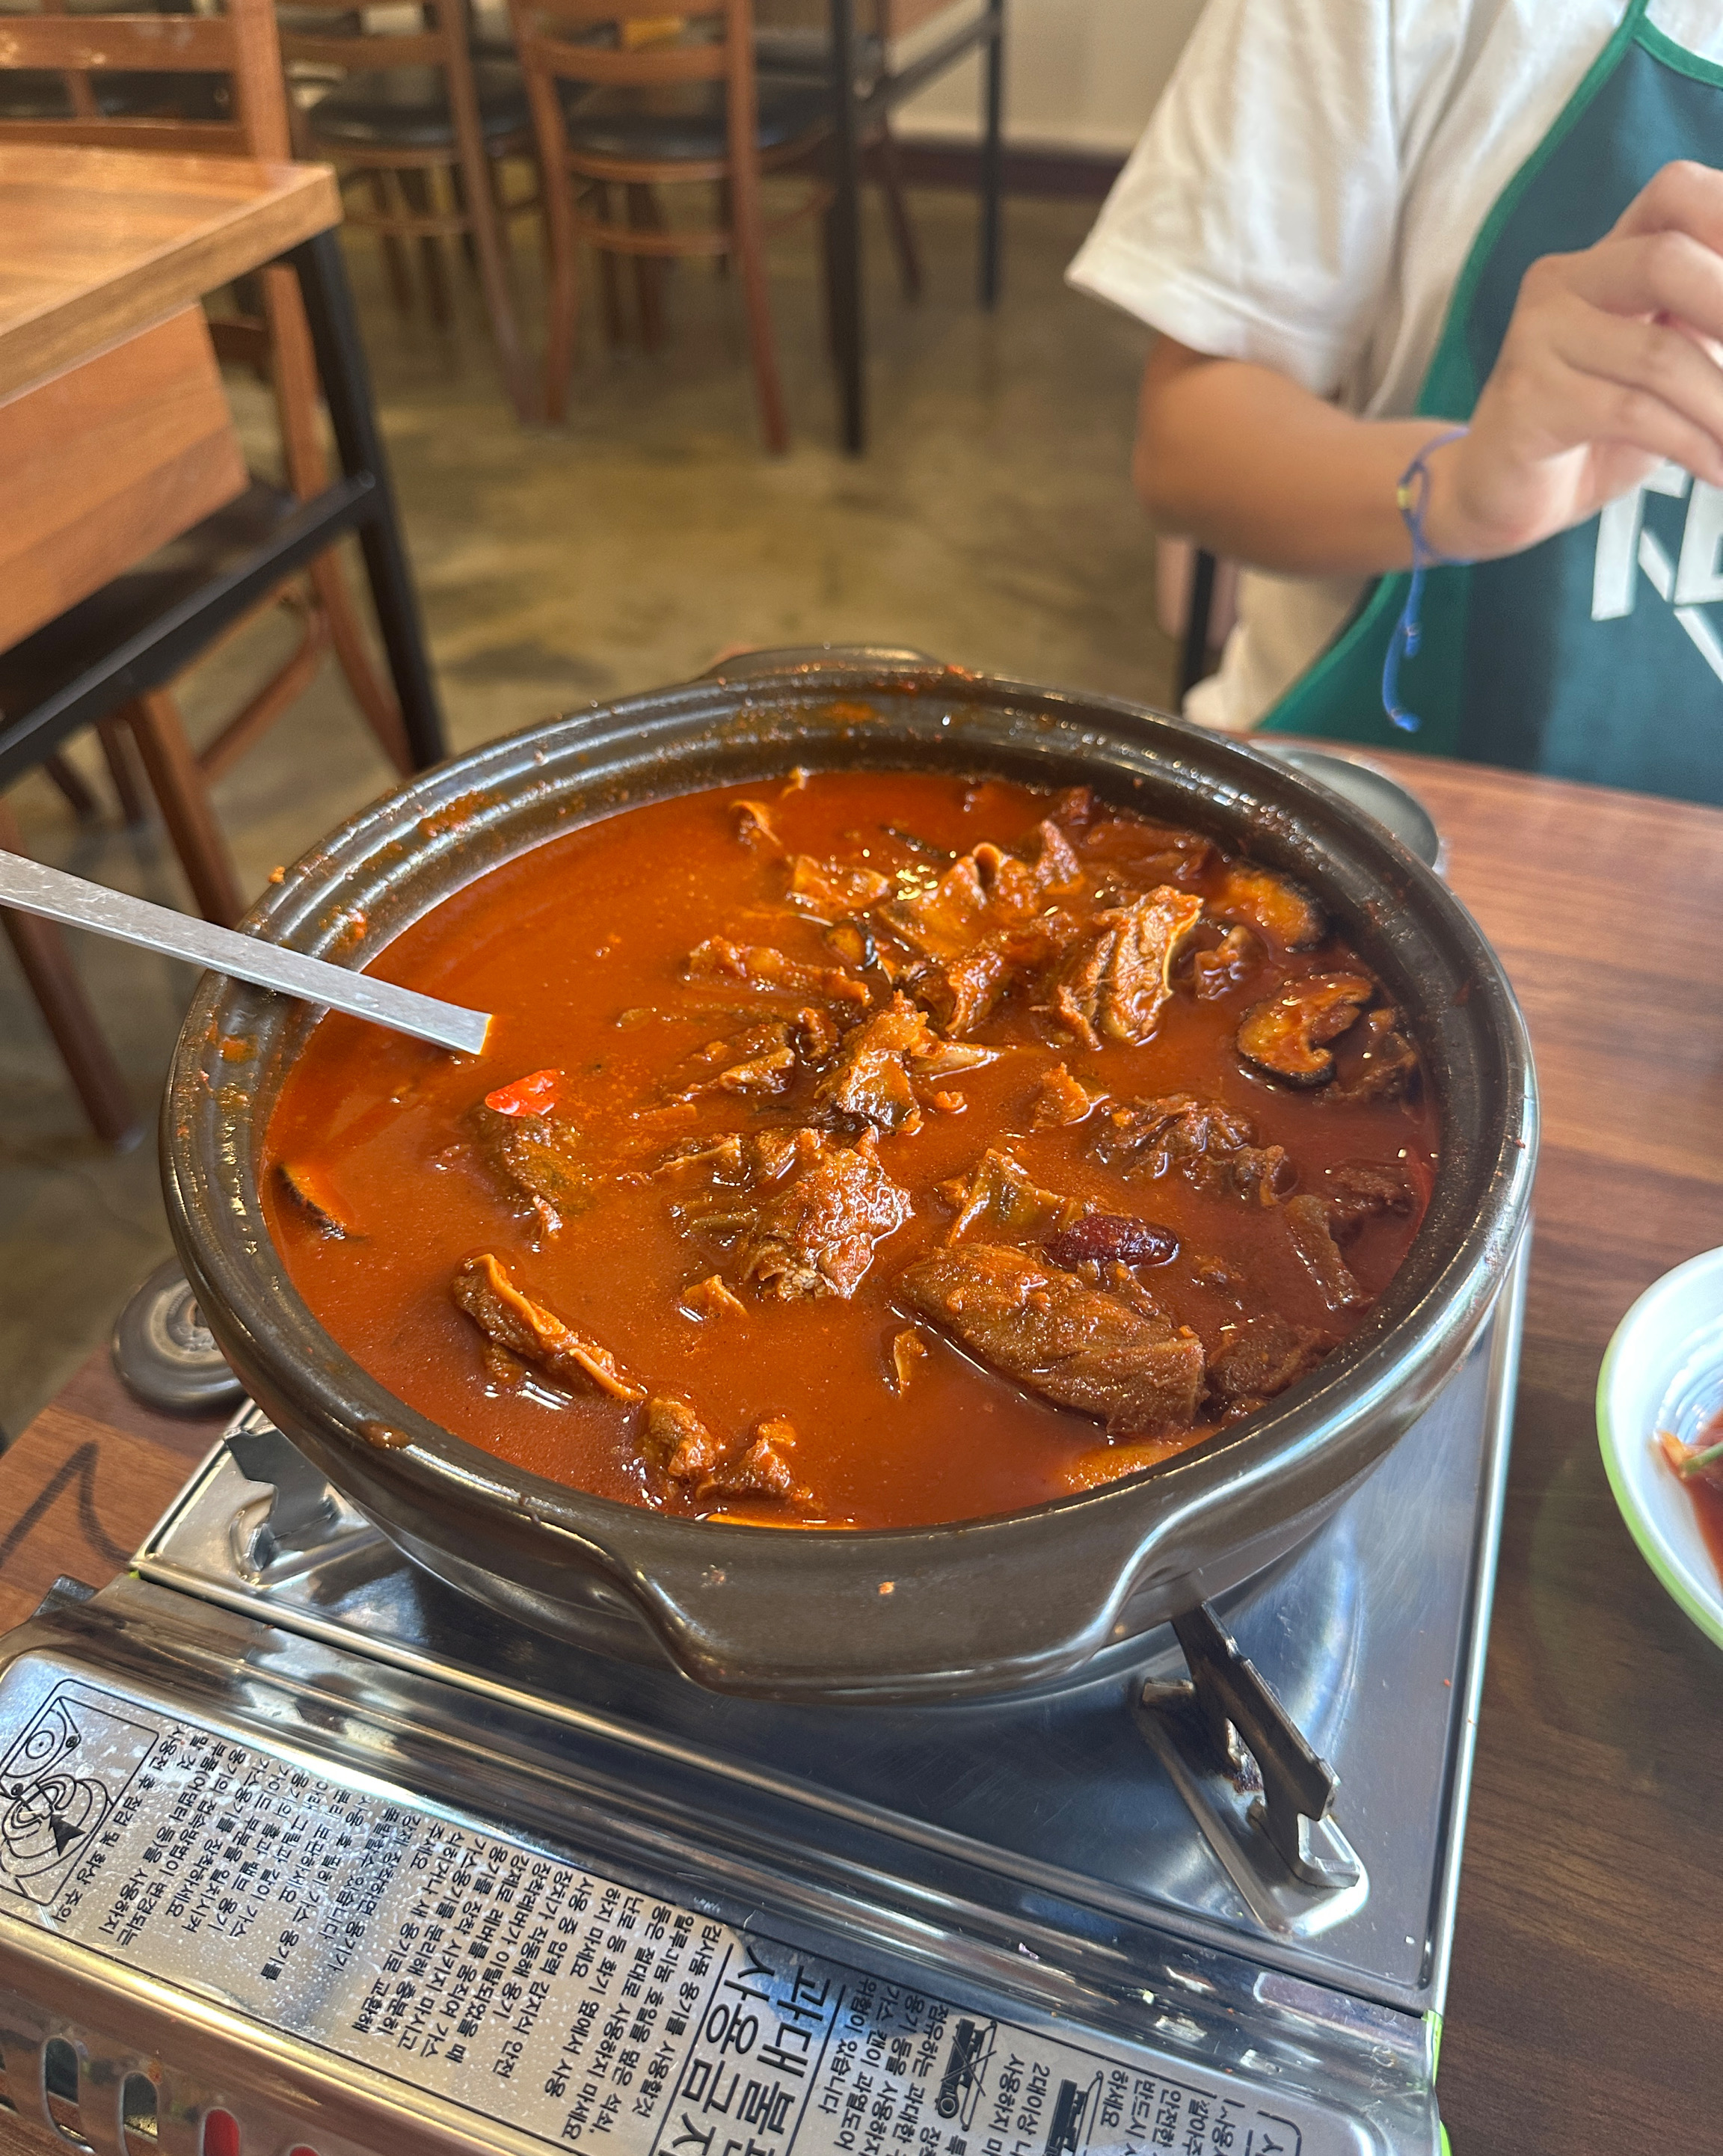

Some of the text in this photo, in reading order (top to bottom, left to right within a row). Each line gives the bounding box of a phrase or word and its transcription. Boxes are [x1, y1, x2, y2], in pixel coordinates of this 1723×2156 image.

[49, 1725, 185, 1923] 사용전 후 점검 및 화상 주의
[176, 1734, 209, 1771] 말 것
[98, 1741, 227, 1935] 부품(어댑터 등)을 사용하지
[116, 1748, 246, 1946] 용기의 접속방법이 변경되는
[165, 1757, 270, 1917] 가스용기를 장착하세요
[181, 1760, 292, 1933] 가이드 부분을 일치시켜
[207, 1769, 312, 1932] 용기의 홈과 밸브 용기
[227, 1776, 329, 1937] 아래 그림과 같이 가스
[260, 1793, 375, 1980] 사용 후 필히 가스 용기를
[277, 1788, 352, 1903] 분리 보관하세요
[318, 1873, 364, 1941] 있습니다
[327, 1811, 421, 1973] 강제 장착하면 용기가
[409, 1819, 445, 1870] 주세요
[351, 1831, 464, 2033] 식히거나 새 용기로 교환해
[376, 1837, 486, 2036] 가스용기를 분리해 충분히
[396, 1846, 508, 2050] 용기를 장착 시키지 마시고
[419, 1854, 529, 2058] 강제로 레버를 움직여 가스
[443, 1862, 551, 2063] 장착레버가 이탈되었을 때
[491, 1870, 573, 2019] 장치가 작동해 용기
[491, 1876, 594, 2078] 사용 중 압력 감지식 안전
[544, 1896, 644, 2098] 난로 등 화기 옆에서 사용
[569, 1888, 621, 1978] 하지 마세요
[875, 1985, 900, 2021] 가스
[560, 1905, 672, 2140] 등은 절대로 사용하지 마세요
[589, 1914, 694, 2134] 알루미늄 호일을 덮은 석쇠,
[631, 1925, 722, 2118] 검사품 용기를 사용할것
[817, 1978, 876, 2114] 위험이 있습니다
[859, 2029, 888, 2068] 캔이
[884, 2038, 912, 2076] 등을
[897, 1994, 924, 2033] 용기
[912, 2004, 949, 2077] 점유하는
[858, 2080, 897, 2155] 사용하지
[891, 2082, 925, 2143] 과대한
[988, 2053, 1025, 2133] 사용하지
[1016, 2062, 1050, 2135] 2대이상
[1099, 2069, 1128, 2128] 하세요
[1124, 2079, 1155, 2139] 반드시
[1151, 2089, 1181, 2148] 안전한
